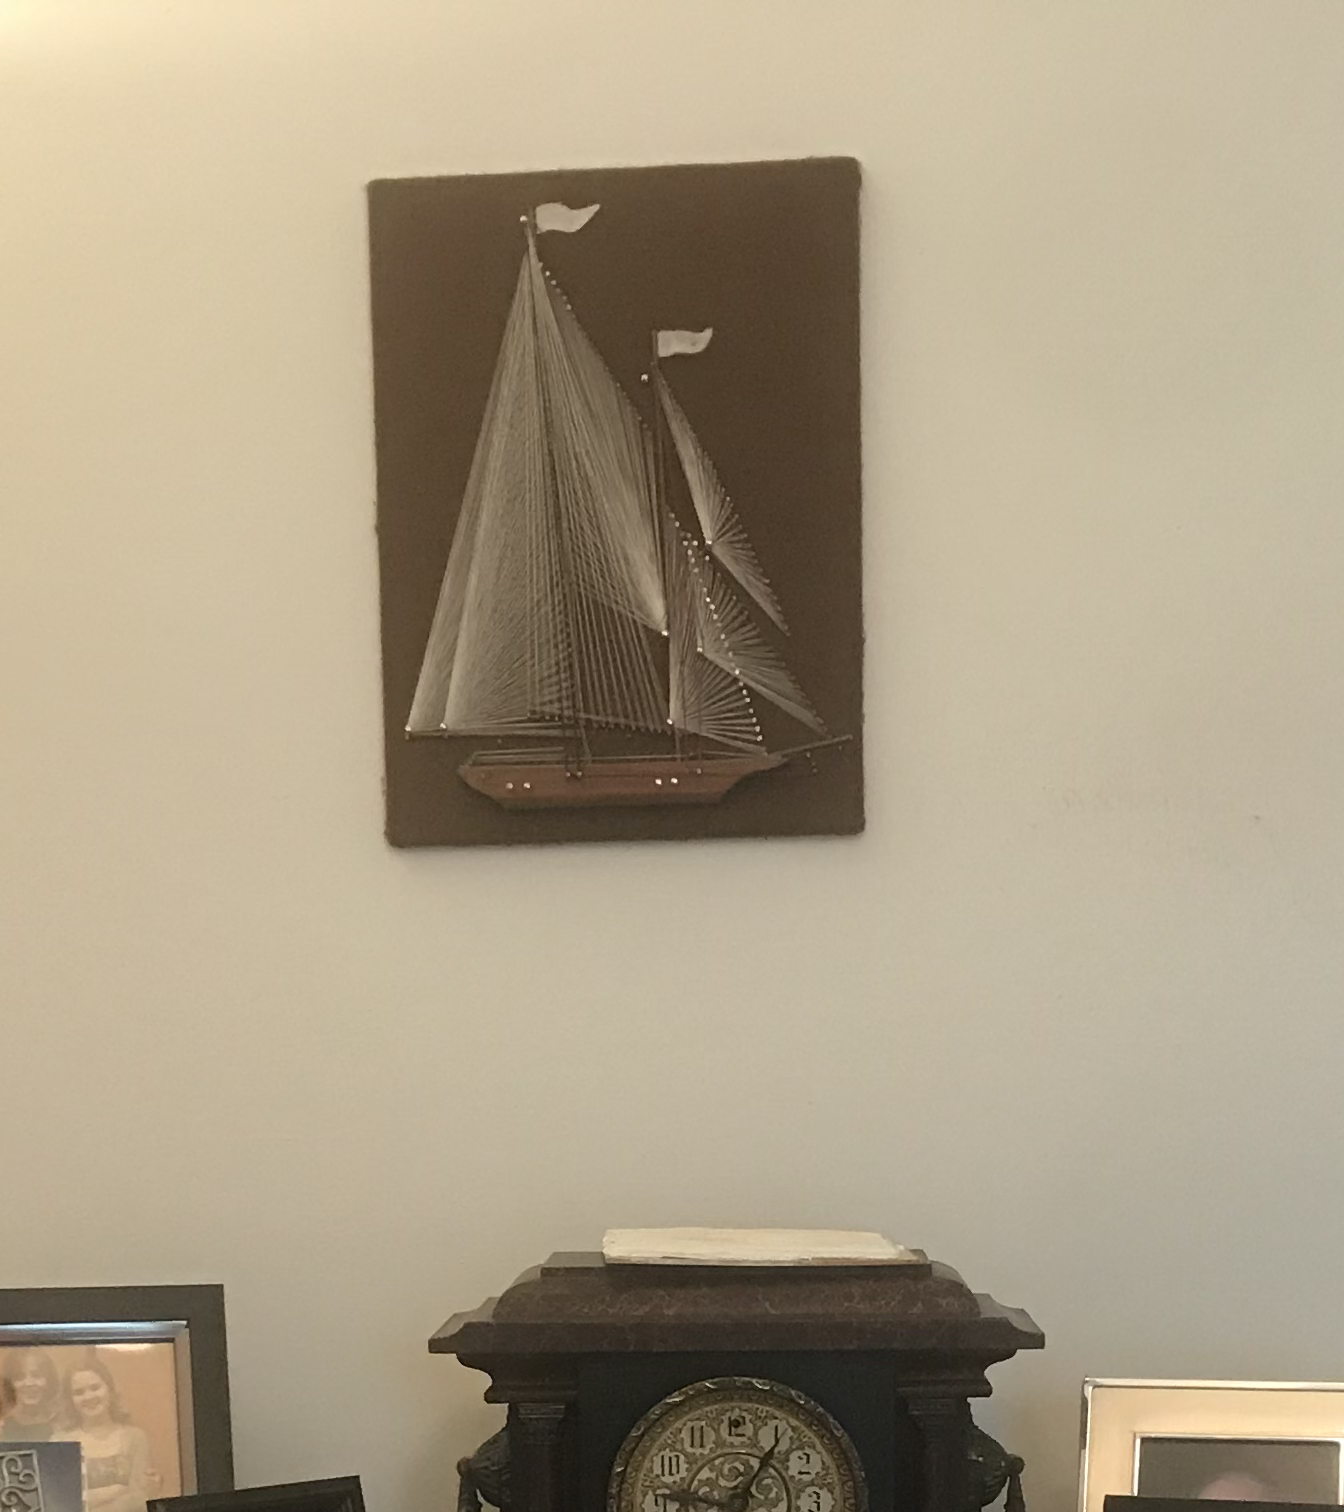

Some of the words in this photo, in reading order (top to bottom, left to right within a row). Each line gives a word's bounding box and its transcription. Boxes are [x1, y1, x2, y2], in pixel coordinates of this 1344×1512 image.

[689, 1424, 705, 1450] 11
[660, 1454, 680, 1477] 10
[798, 1452, 811, 1475] 2
